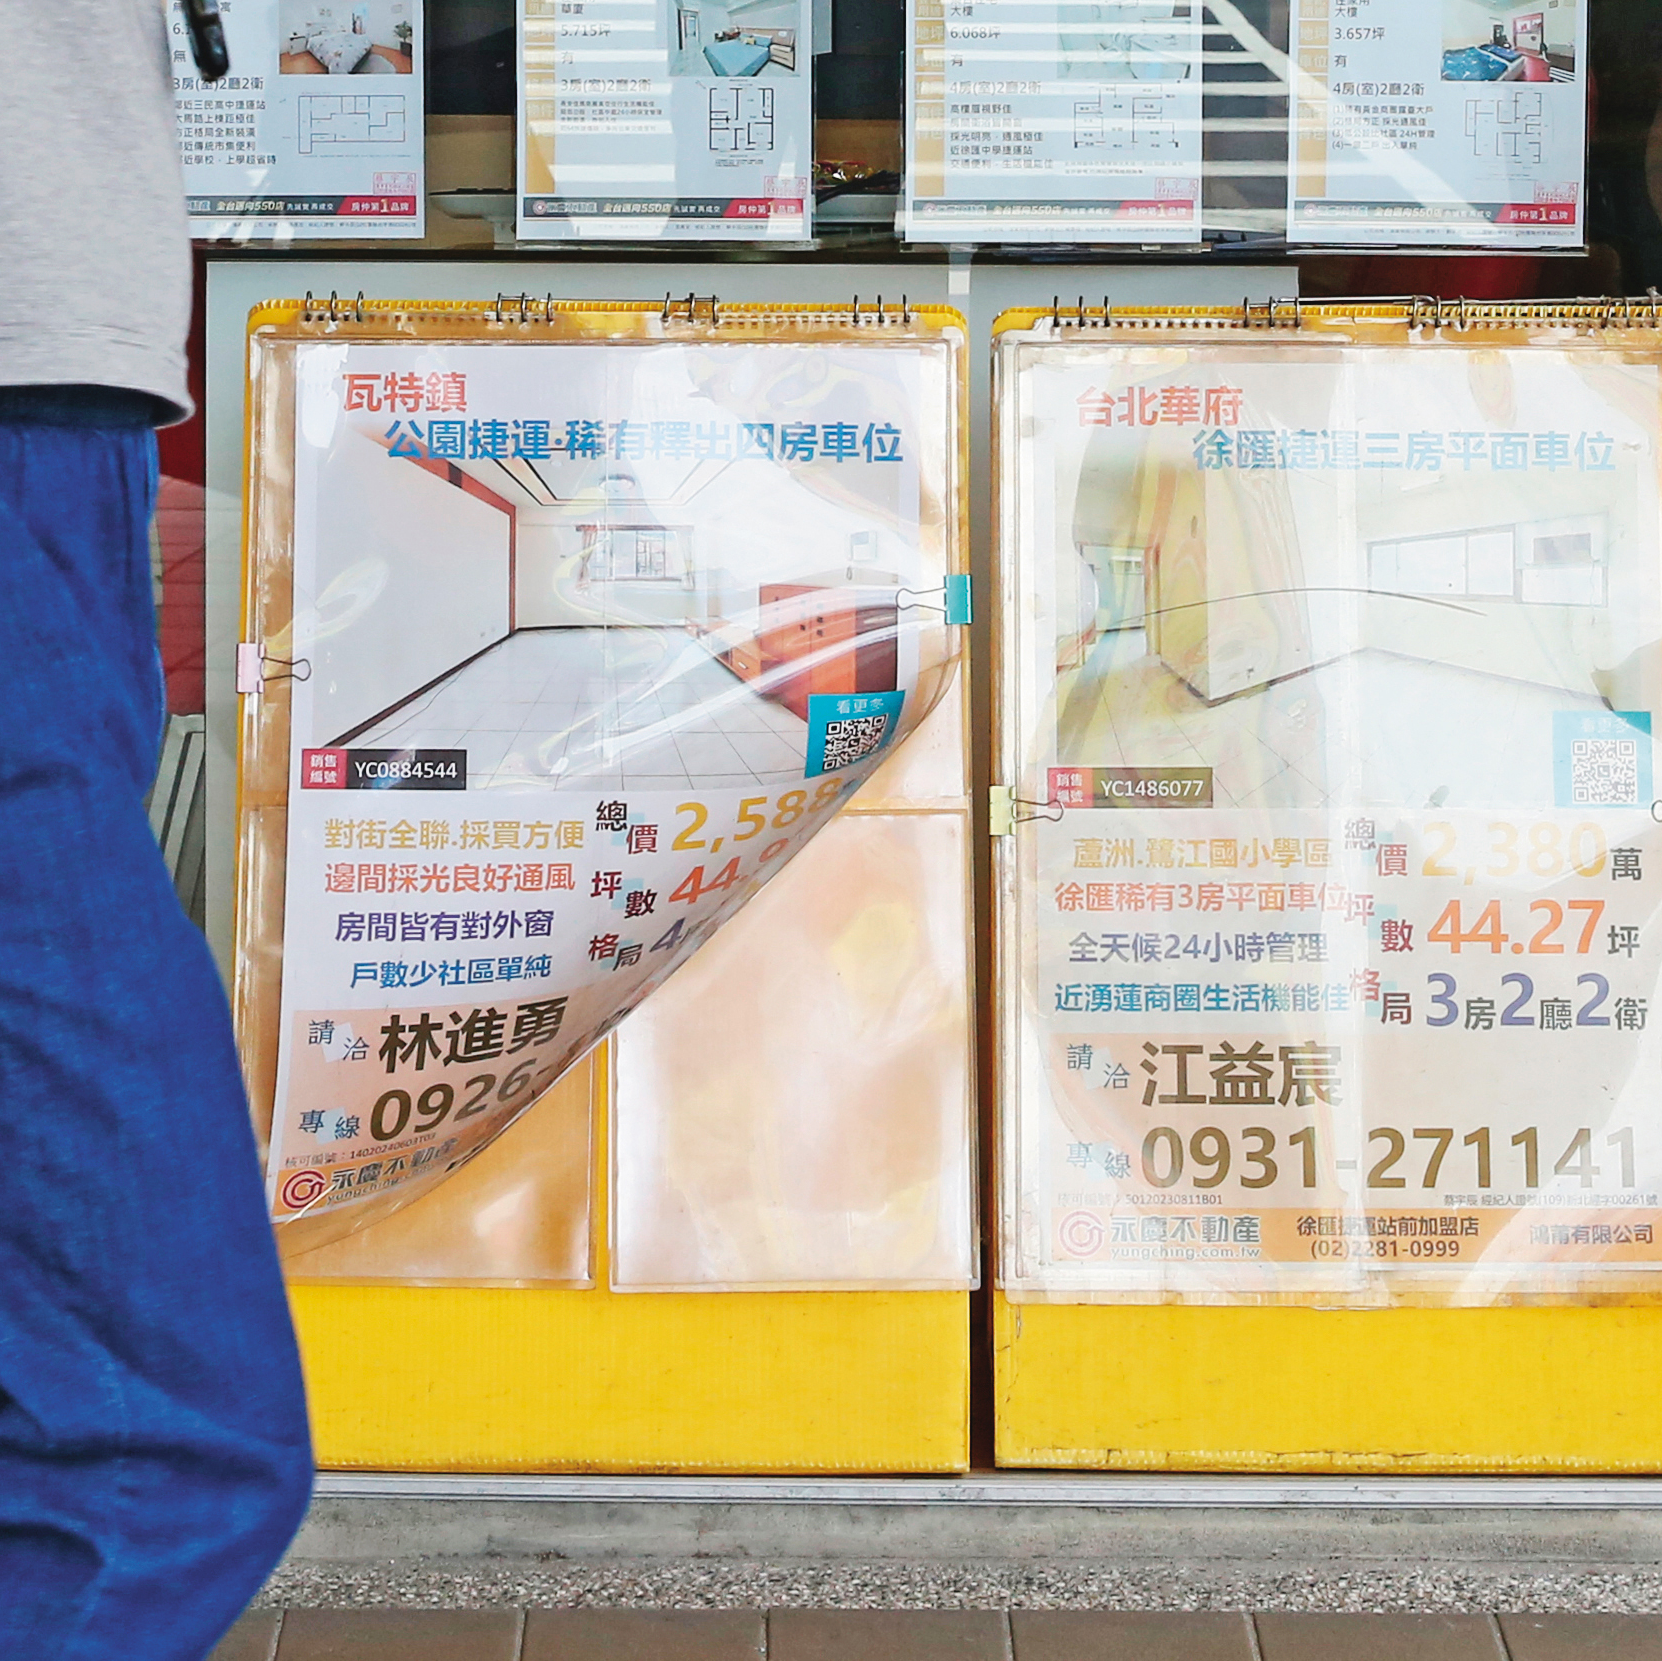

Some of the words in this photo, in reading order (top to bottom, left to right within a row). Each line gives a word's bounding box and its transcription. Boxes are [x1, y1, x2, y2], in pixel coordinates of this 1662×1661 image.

[343, 372, 467, 413] 瓦特鎮
[1076, 385, 1243, 429] 台北華府
[1193, 429, 1616, 474] 徐匯捷運三房平面車位
[836, 696, 884, 714] 看更多
[310, 753, 337, 768] 銷售
[354, 760, 457, 781] YC0884544
[310, 769, 337, 784] 編號
[1057, 773, 1082, 788] 銷售
[1100, 778, 1204, 799] YC1486077
[671, 777, 843, 853] 2,588
[324, 818, 585, 852] 對街全聯.採買方便
[324, 862, 576, 894] 邊間採光良好通風
[1055, 883, 1347, 913] 徐匯稀有3房平面車位
[335, 910, 554, 942] 房間皆有對外窗
[1069, 933, 1329, 964] 全天候24小時管理
[351, 954, 552, 989] 戶數少社區單純
[1055, 983, 1351, 1014] 近湧蓮商圈生活機能佳
[379, 996, 569, 1075] 林進勇
[1141, 1041, 1342, 1107] 江益宸
[370, 1058, 551, 1141] 0926-
[1141, 1125, 1637, 1190] 0931-271141
[1110, 1216, 1260, 1245] 永慶不動產
[1297, 1216, 1479, 1238] 徐匯捷運站前加盟店
[1529, 1223, 1654, 1245] 鴻莆有限公司
[1110, 1245, 1260, 1261] yungching.com.tw
[1311, 1239, 1460, 1261] (02)2281-0999
